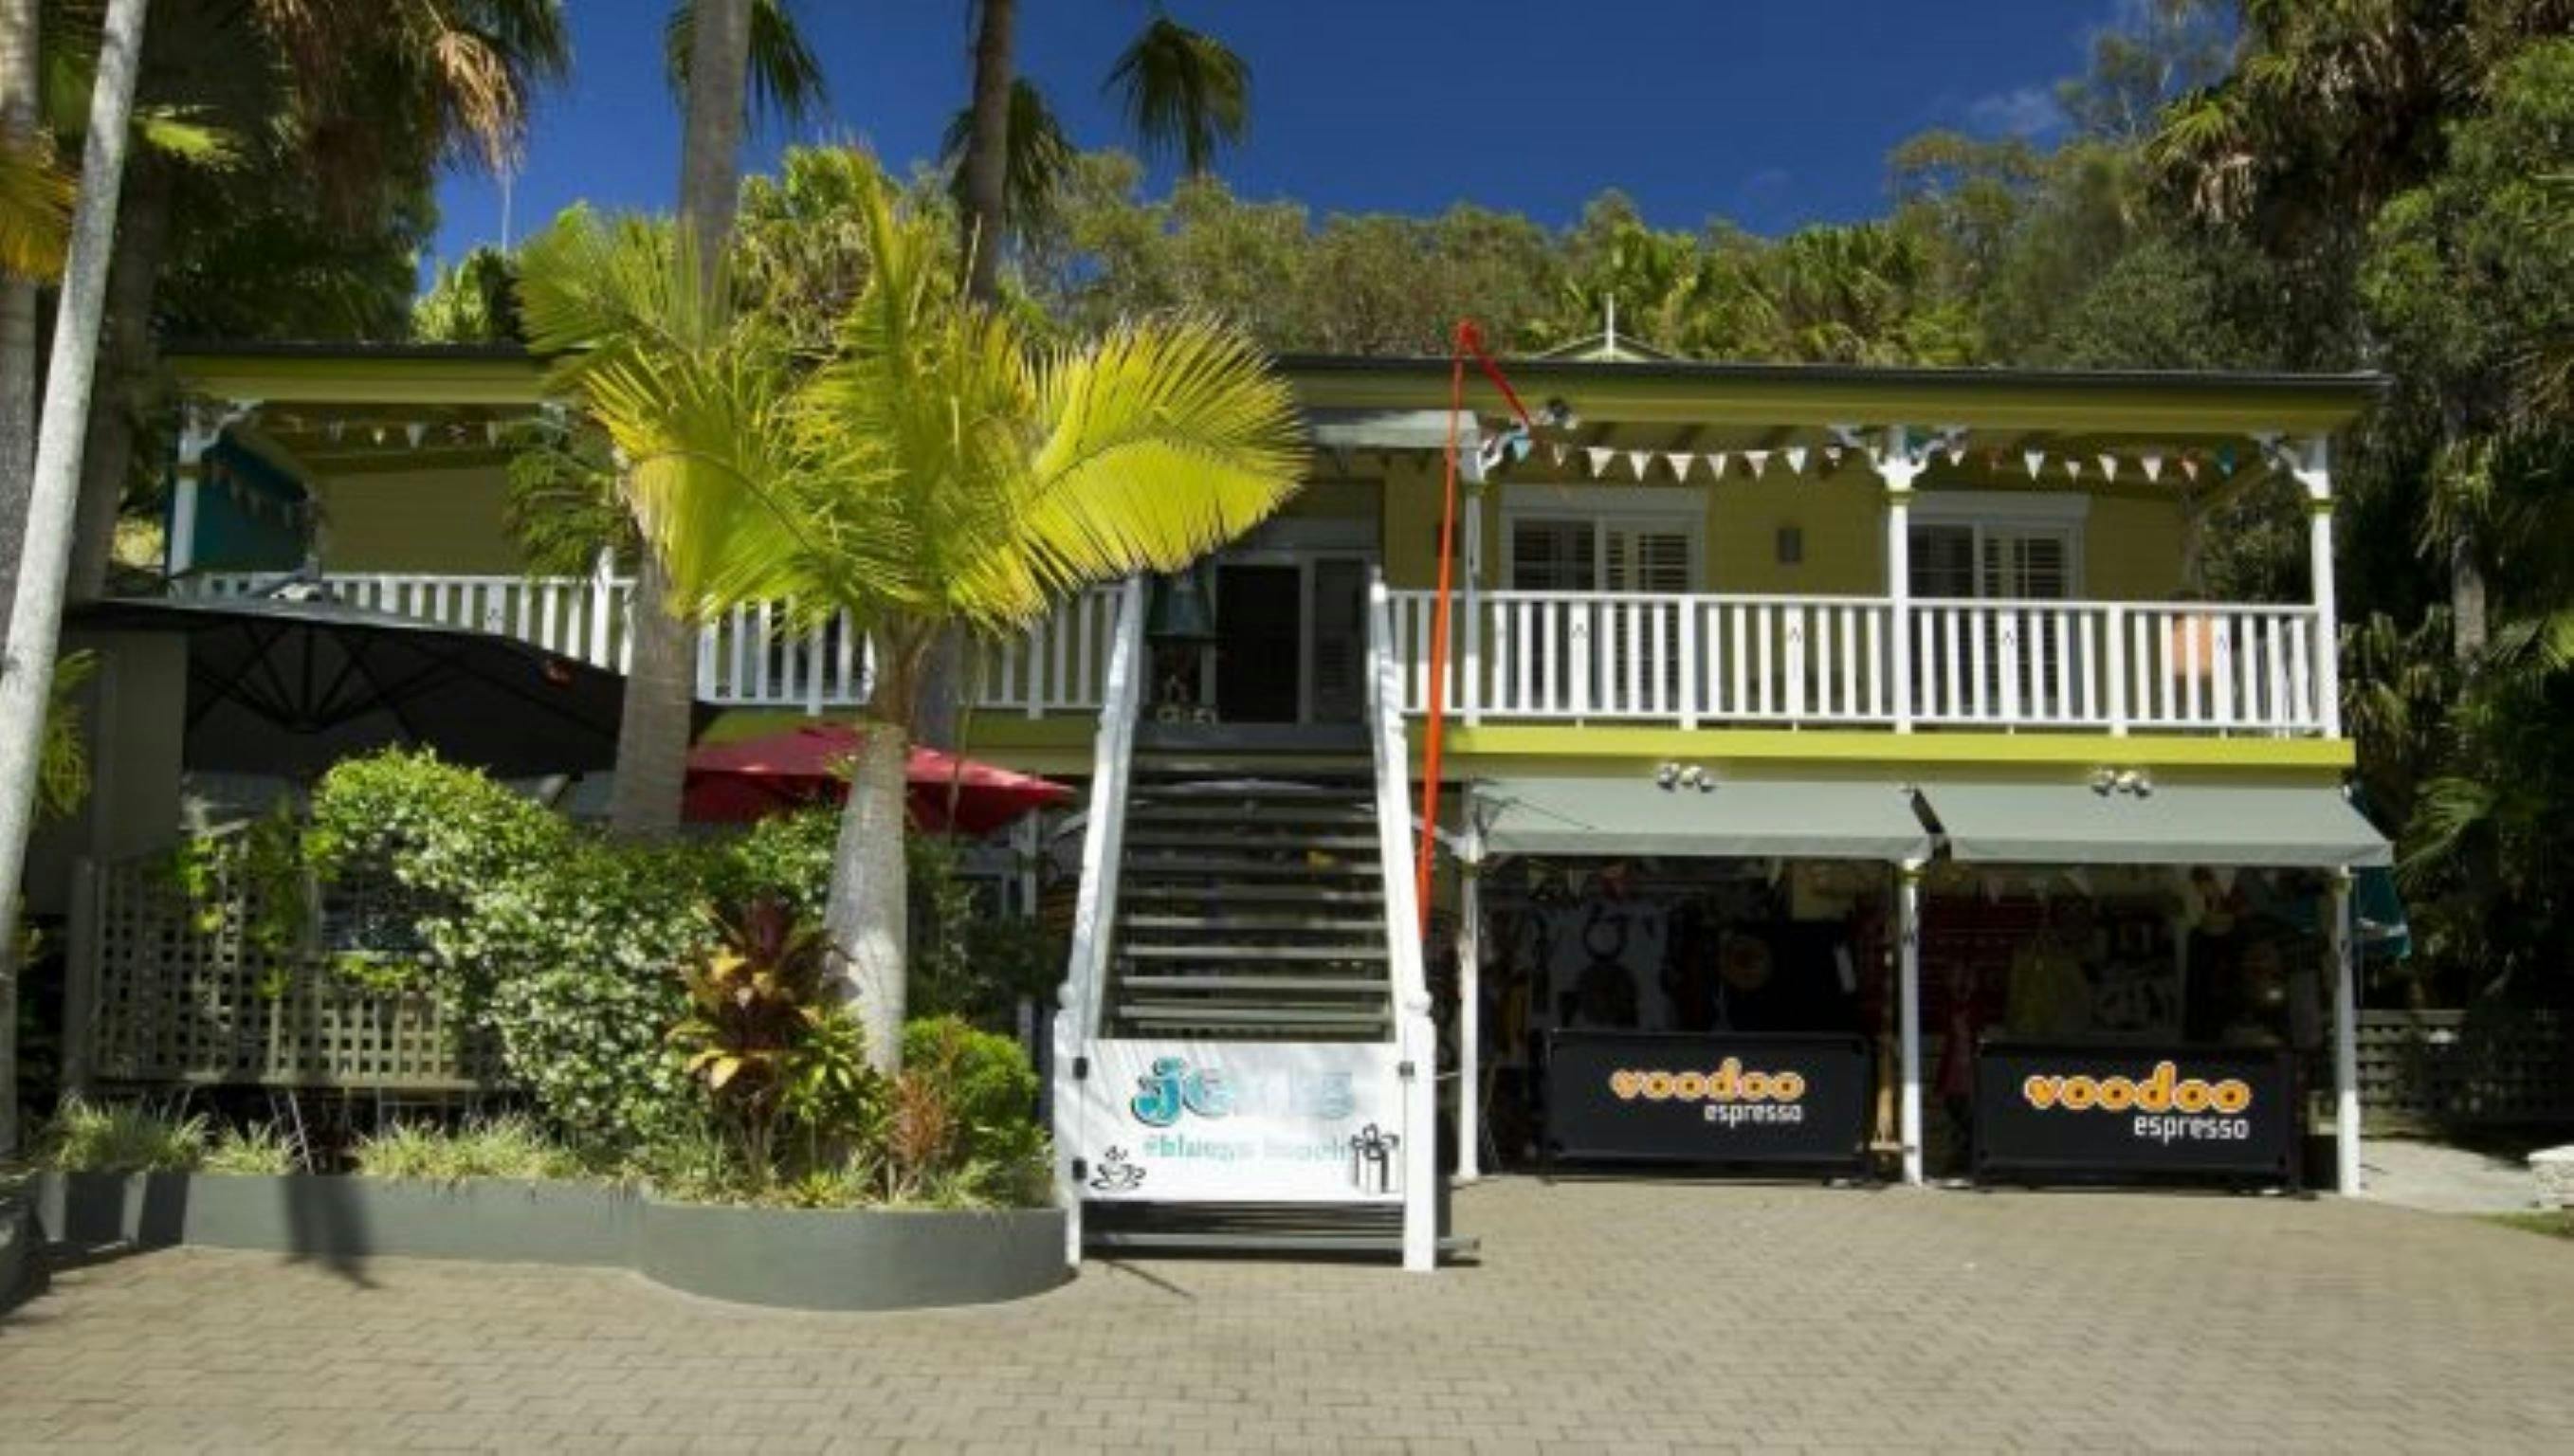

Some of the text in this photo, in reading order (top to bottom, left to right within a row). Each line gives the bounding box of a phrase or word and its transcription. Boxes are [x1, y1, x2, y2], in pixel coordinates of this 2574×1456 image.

[1609, 1056, 1805, 1101] voodoo
[2023, 1060, 2252, 1113] voodoo
[1704, 1103, 1803, 1129] espresso
[2134, 1115, 2250, 1145] espresso
